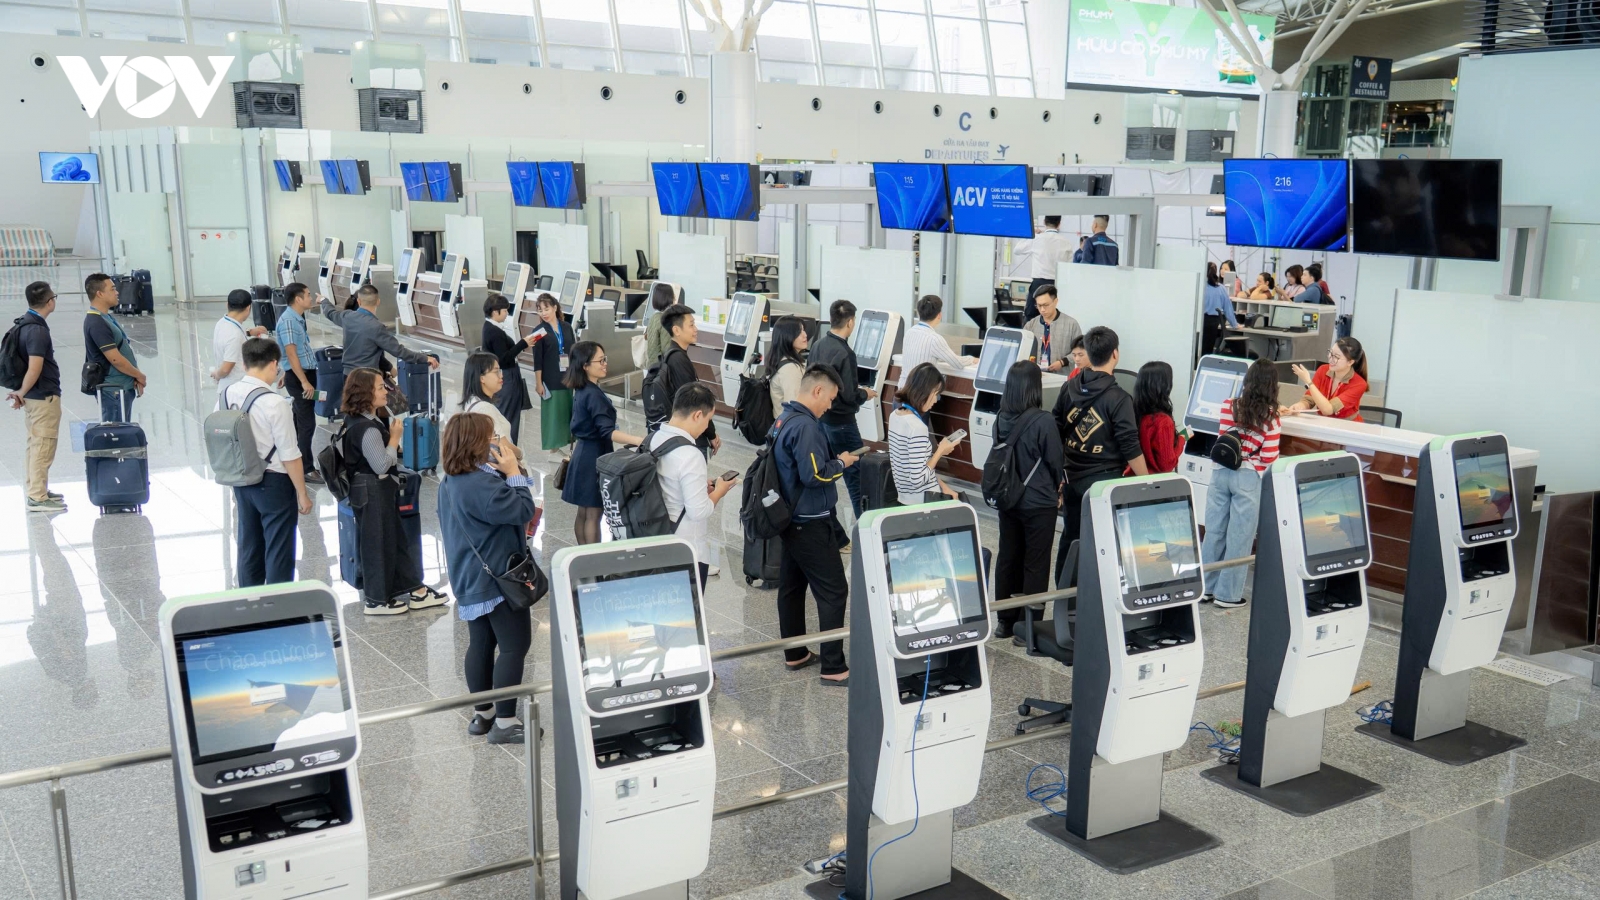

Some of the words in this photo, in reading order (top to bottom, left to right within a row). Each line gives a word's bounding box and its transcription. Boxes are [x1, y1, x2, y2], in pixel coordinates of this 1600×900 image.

[1359, 81, 1378, 89] COFFEE
[1354, 88, 1386, 97] RESTAURANT
[959, 112, 972, 131] C
[925, 148, 989, 160] DEPARTURES
[1275, 176, 1291, 187] 2:16
[953, 186, 987, 207] ACV
[204, 649, 256, 672] Chào
[263, 642, 318, 661] mừng
